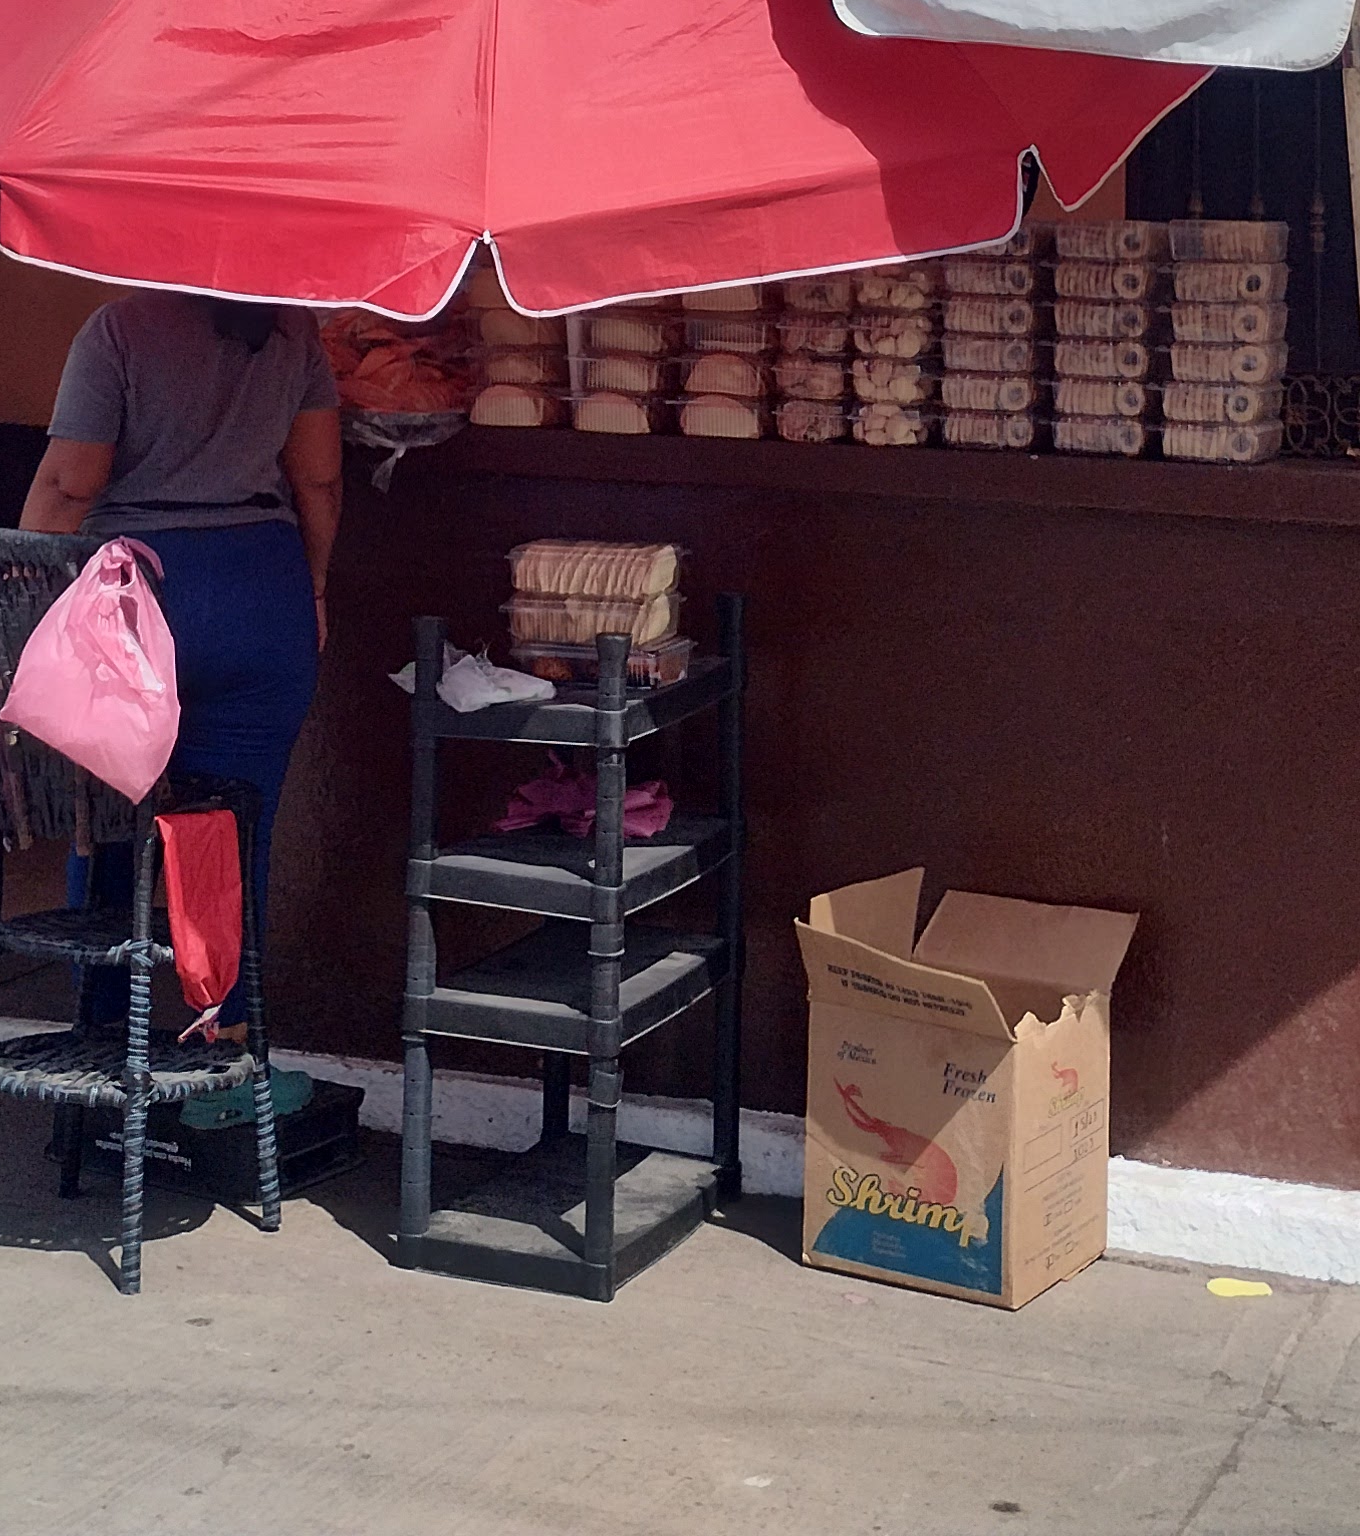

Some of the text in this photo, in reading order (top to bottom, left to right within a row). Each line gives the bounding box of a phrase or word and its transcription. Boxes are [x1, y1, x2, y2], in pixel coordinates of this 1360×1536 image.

[943, 1062, 987, 1084] Fresh
[942, 1079, 996, 1104] Frozen
[826, 1166, 989, 1248] Shrimp
